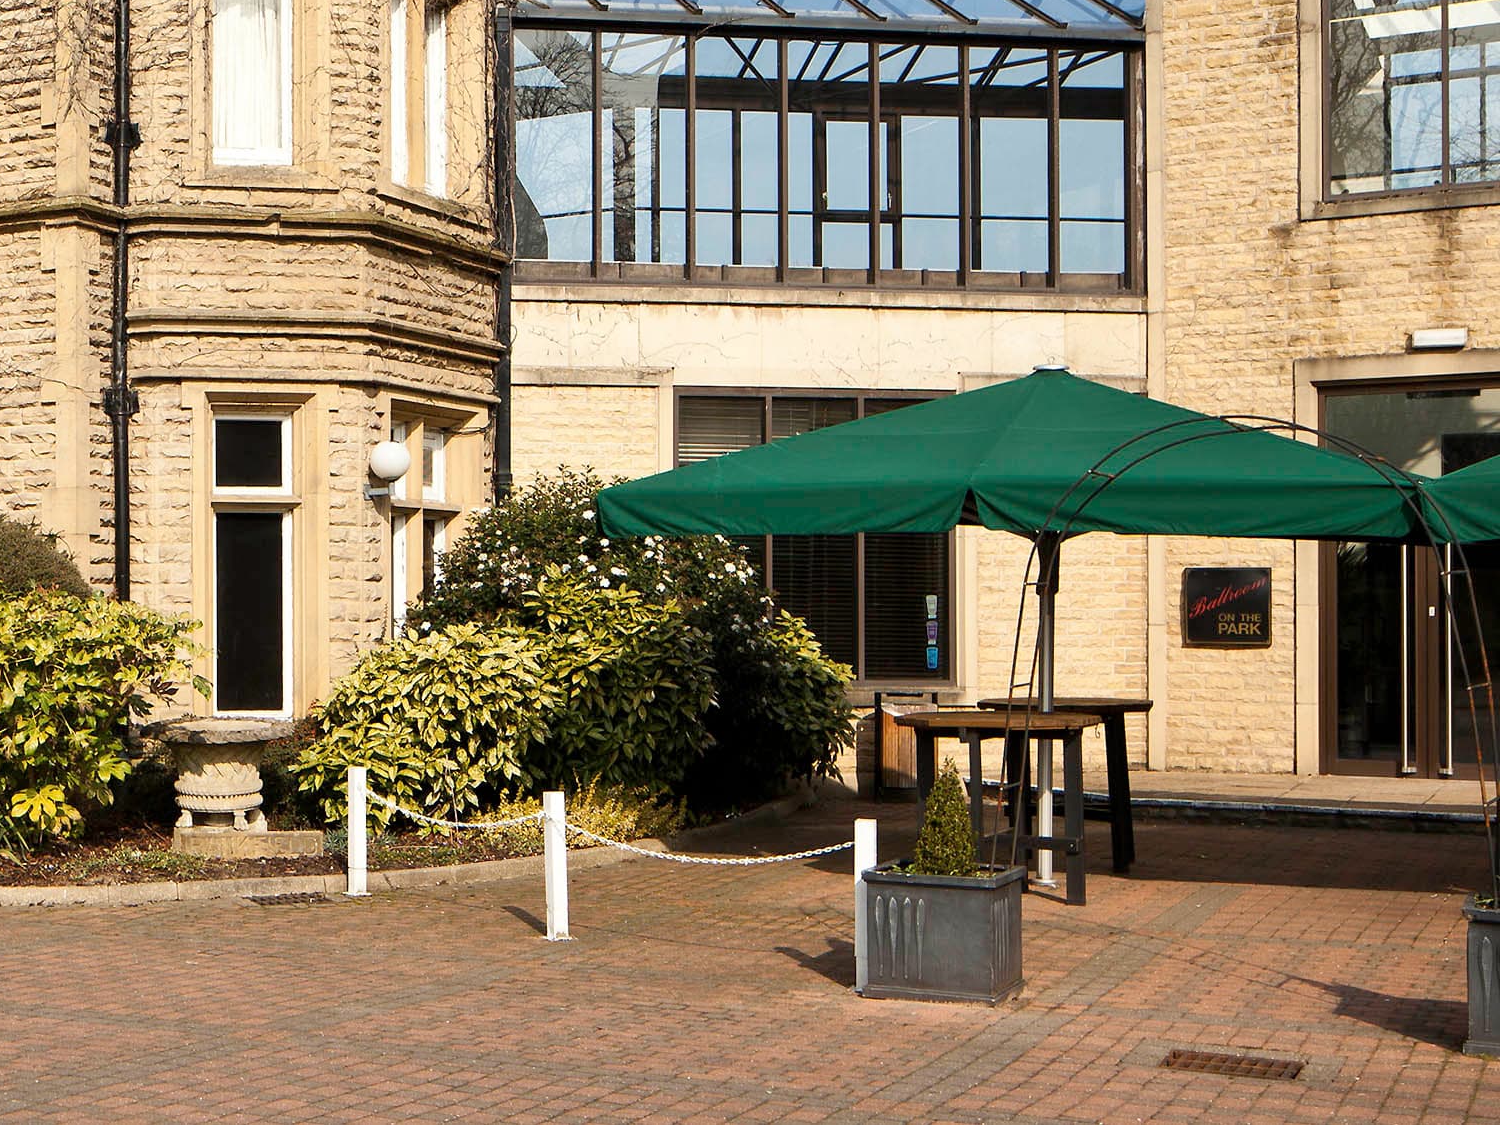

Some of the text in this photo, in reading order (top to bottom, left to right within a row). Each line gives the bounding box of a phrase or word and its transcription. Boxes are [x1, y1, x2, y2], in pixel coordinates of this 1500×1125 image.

[1189, 576, 1268, 618] Ballroom
[1218, 613, 1262, 622] ON THE
[1218, 623, 1261, 634] PARK
